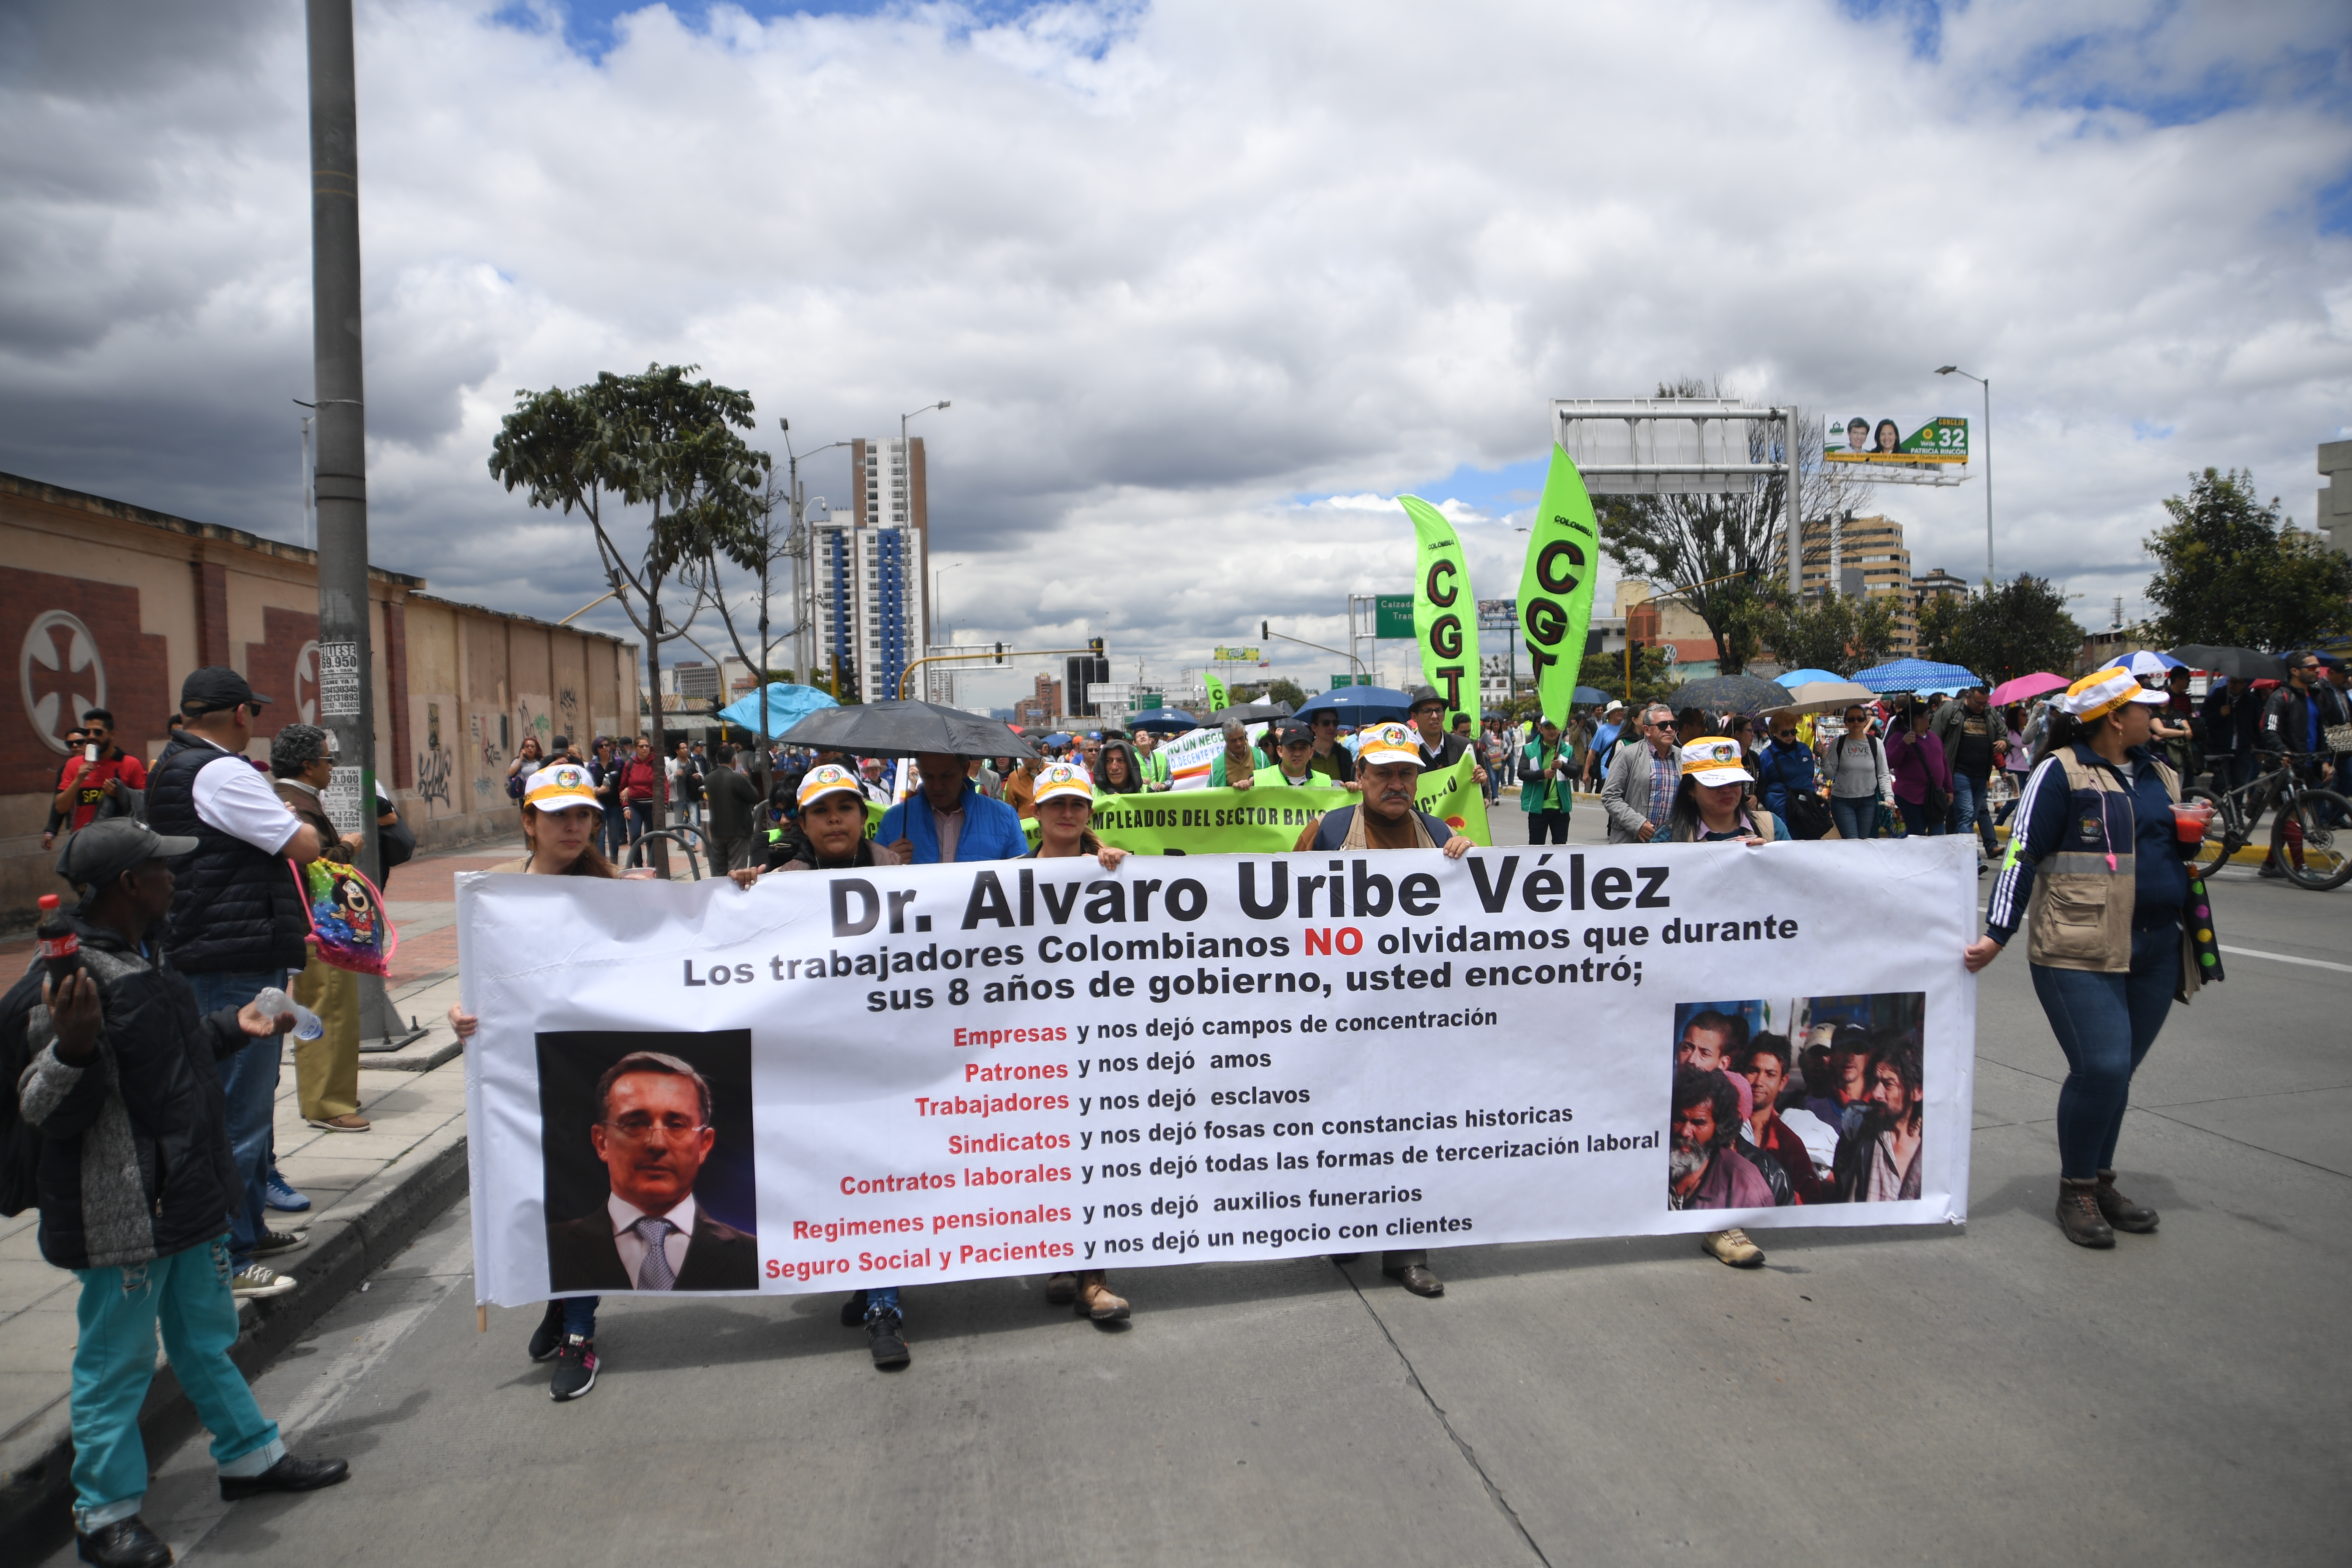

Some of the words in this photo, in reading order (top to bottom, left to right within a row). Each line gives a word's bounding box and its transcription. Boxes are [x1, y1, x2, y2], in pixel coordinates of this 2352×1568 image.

[1938, 428, 1965, 447] 32
[1428, 539, 1454, 550] COLOMBIA
[1554, 515, 1593, 539] COLOMBIA
[1426, 558, 1465, 712] CGT
[320, 656, 357, 669] 69.950
[2106, 693, 2128, 709] UTRADEC
[1182, 737, 1196, 751] UN
[1182, 809, 1210, 827] DEL
[1215, 807, 1278, 826] SECTOR
[830, 879, 931, 938] Dr.
[961, 869, 1207, 930] Alvaro
[1239, 860, 1443, 920] Uribe
[1466, 854, 1670, 913] Vélez
[685, 960, 754, 986] Los
[770, 943, 1024, 982] trabajadores
[1038, 932, 1289, 963] Colombianos
[1305, 927, 1363, 956] NO
[1378, 926, 1570, 954] olvidamos
[1584, 926, 1649, 954] que
[1662, 915, 1798, 944] durante
[867, 988, 934, 1012] sus
[948, 978, 969, 1005] 8
[983, 974, 1074, 1003] años
[1089, 971, 1134, 997] de
[1149, 967, 1331, 1003] gobierno,
[1347, 962, 1451, 991] usted
[1465, 955, 1642, 986] encontró;
[954, 1027, 1067, 1048] Empresas
[1077, 1026, 1089, 1044] y
[1098, 1024, 1137, 1038] nos
[1146, 1017, 1194, 1041] dejó
[1203, 1020, 1292, 1038] campos
[1300, 1015, 1327, 1032] de
[1336, 1008, 1497, 1032] concentración
[966, 1063, 1067, 1082] Patrones
[1078, 1059, 1090, 1078] y
[1099, 1058, 1138, 1072] nos
[1147, 1051, 1195, 1074] dejó
[1211, 1054, 1271, 1068] amos
[915, 1093, 1069, 1118] Trabajadores
[1079, 1097, 1091, 1116] y
[1100, 1095, 1139, 1110] nos
[1148, 1088, 1195, 1111] dejó
[1211, 1086, 1309, 1105] esclavos
[949, 1132, 1070, 1154] Sindicatos
[1080, 1132, 1092, 1150] y
[1101, 1129, 1140, 1144] nos
[1149, 1122, 1196, 1145] dejó
[1204, 1121, 1265, 1138] fosas
[1273, 1122, 1313, 1136] con
[1322, 1112, 1457, 1135] constancias
[1466, 1107, 1572, 1127] historicas
[841, 1172, 955, 1195] Contratos
[965, 1164, 1071, 1186] laborales
[1081, 1166, 1093, 1184] y
[1102, 1163, 1141, 1178] nos
[1150, 1155, 1197, 1179] dejó
[1206, 1154, 1268, 1172] todas
[1277, 1152, 1309, 1169] las
[1317, 1150, 1394, 1168] formas
[1402, 1146, 1428, 1163] de
[1436, 1137, 1579, 1162] tercerización
[1588, 1131, 1658, 1152] laboral
[793, 1217, 923, 1242] Regimenes
[933, 1204, 1071, 1234] pensionales
[1083, 1206, 1094, 1224] y
[1103, 1203, 1142, 1218] nos
[1151, 1195, 1198, 1219] dejó
[1214, 1191, 1301, 1211] auxilios
[1309, 1186, 1422, 1206] funerarios
[767, 1259, 849, 1281] Seguro
[859, 1248, 930, 1271] Social
[939, 1252, 951, 1270] y
[960, 1240, 1073, 1263] Pacientes
[1084, 1241, 1096, 1260] y
[1105, 1238, 1143, 1253] nos
[1152, 1230, 1199, 1253] dejó
[1208, 1233, 1233, 1247] un
[1243, 1223, 1330, 1247] negocio
[1339, 1224, 1377, 1239] con
[1386, 1216, 1472, 1235] clientes
